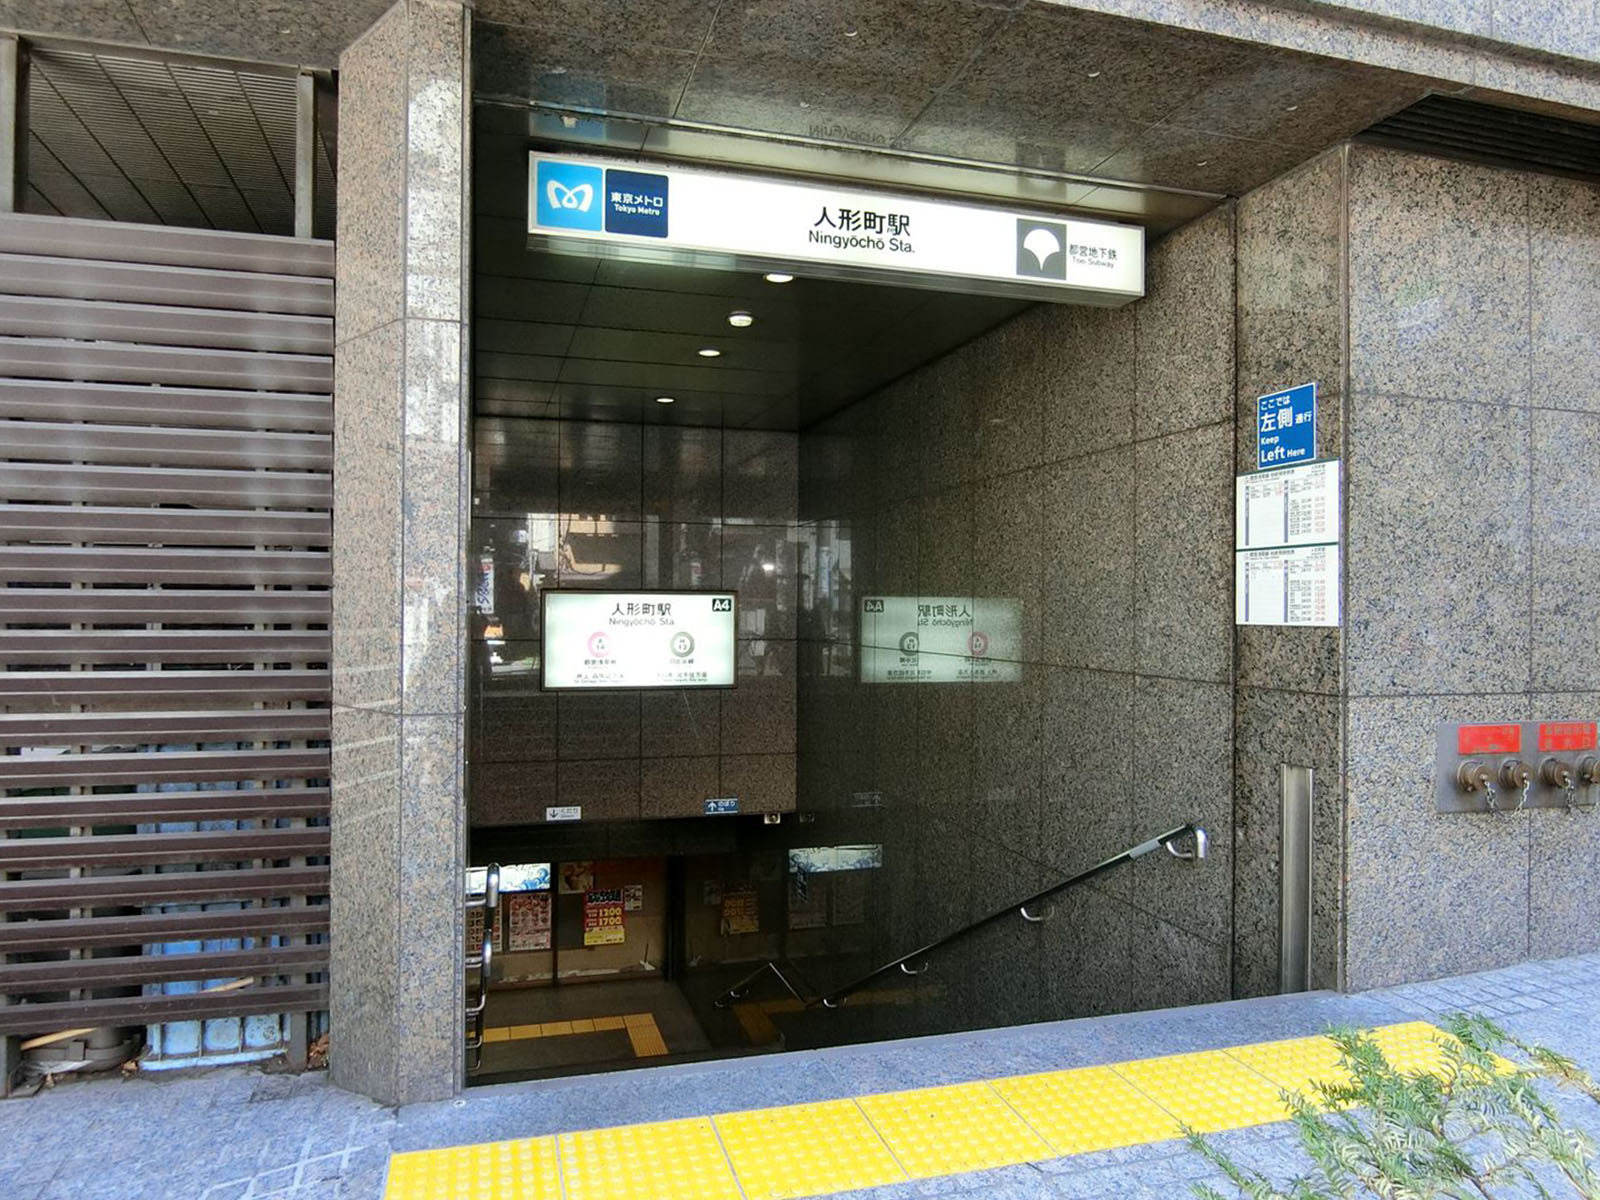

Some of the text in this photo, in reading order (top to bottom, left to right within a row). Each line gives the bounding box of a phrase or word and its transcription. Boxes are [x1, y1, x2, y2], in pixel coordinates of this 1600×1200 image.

[611, 191, 663, 207] 東京メトロ
[614, 203, 660, 216] Tokyo Metro
[814, 206, 911, 236] 人形町駅
[809, 230, 915, 253] Ningyōchō Sta.
[1069, 244, 1118, 260] 都営地下鉄
[1261, 395, 1291, 411] ここでは
[1261, 436, 1279, 445] Keep
[1261, 446, 1305, 462] Left Here
[612, 602, 671, 616] 人形町駅
[713, 600, 731, 611] A4
